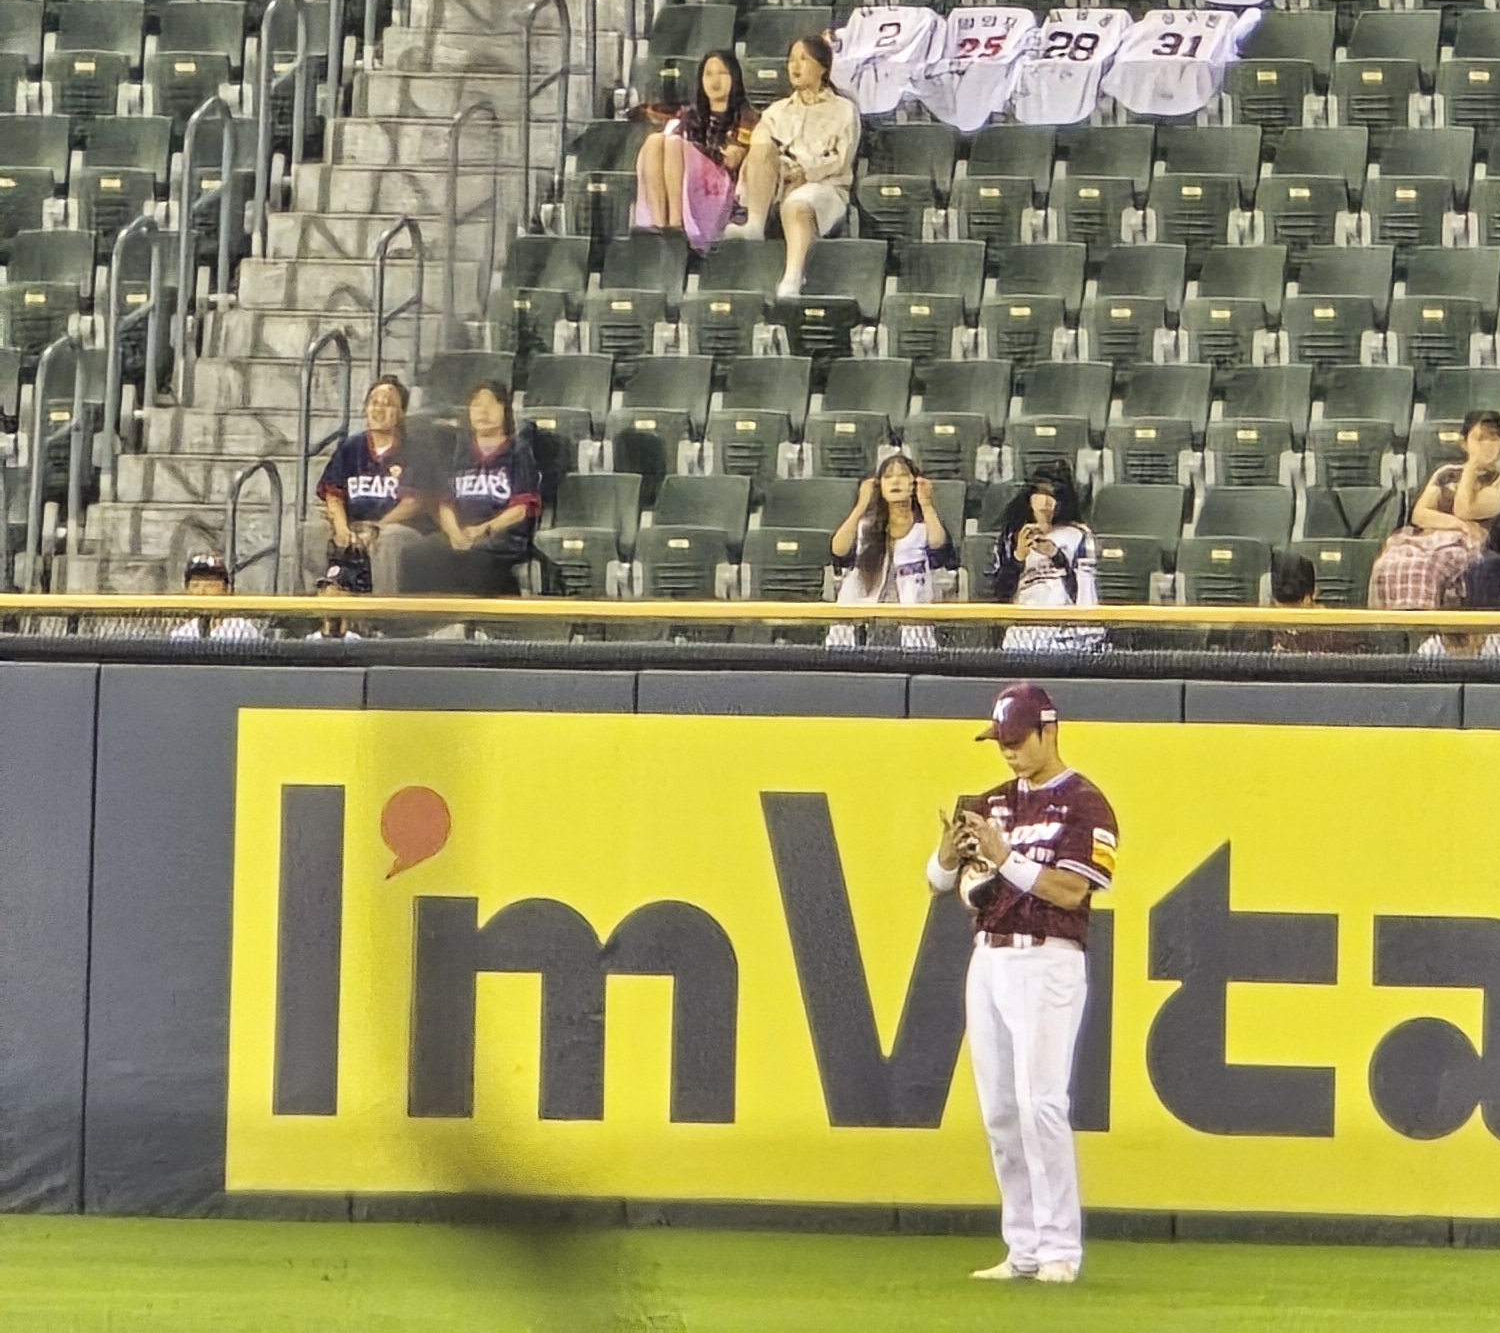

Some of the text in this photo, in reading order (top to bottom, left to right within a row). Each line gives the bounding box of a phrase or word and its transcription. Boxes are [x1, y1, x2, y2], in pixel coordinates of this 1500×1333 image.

[875, 22, 901, 48] 2
[954, 34, 1006, 59] 25
[1043, 31, 1100, 61] 28
[1152, 32, 1203, 58] 31
